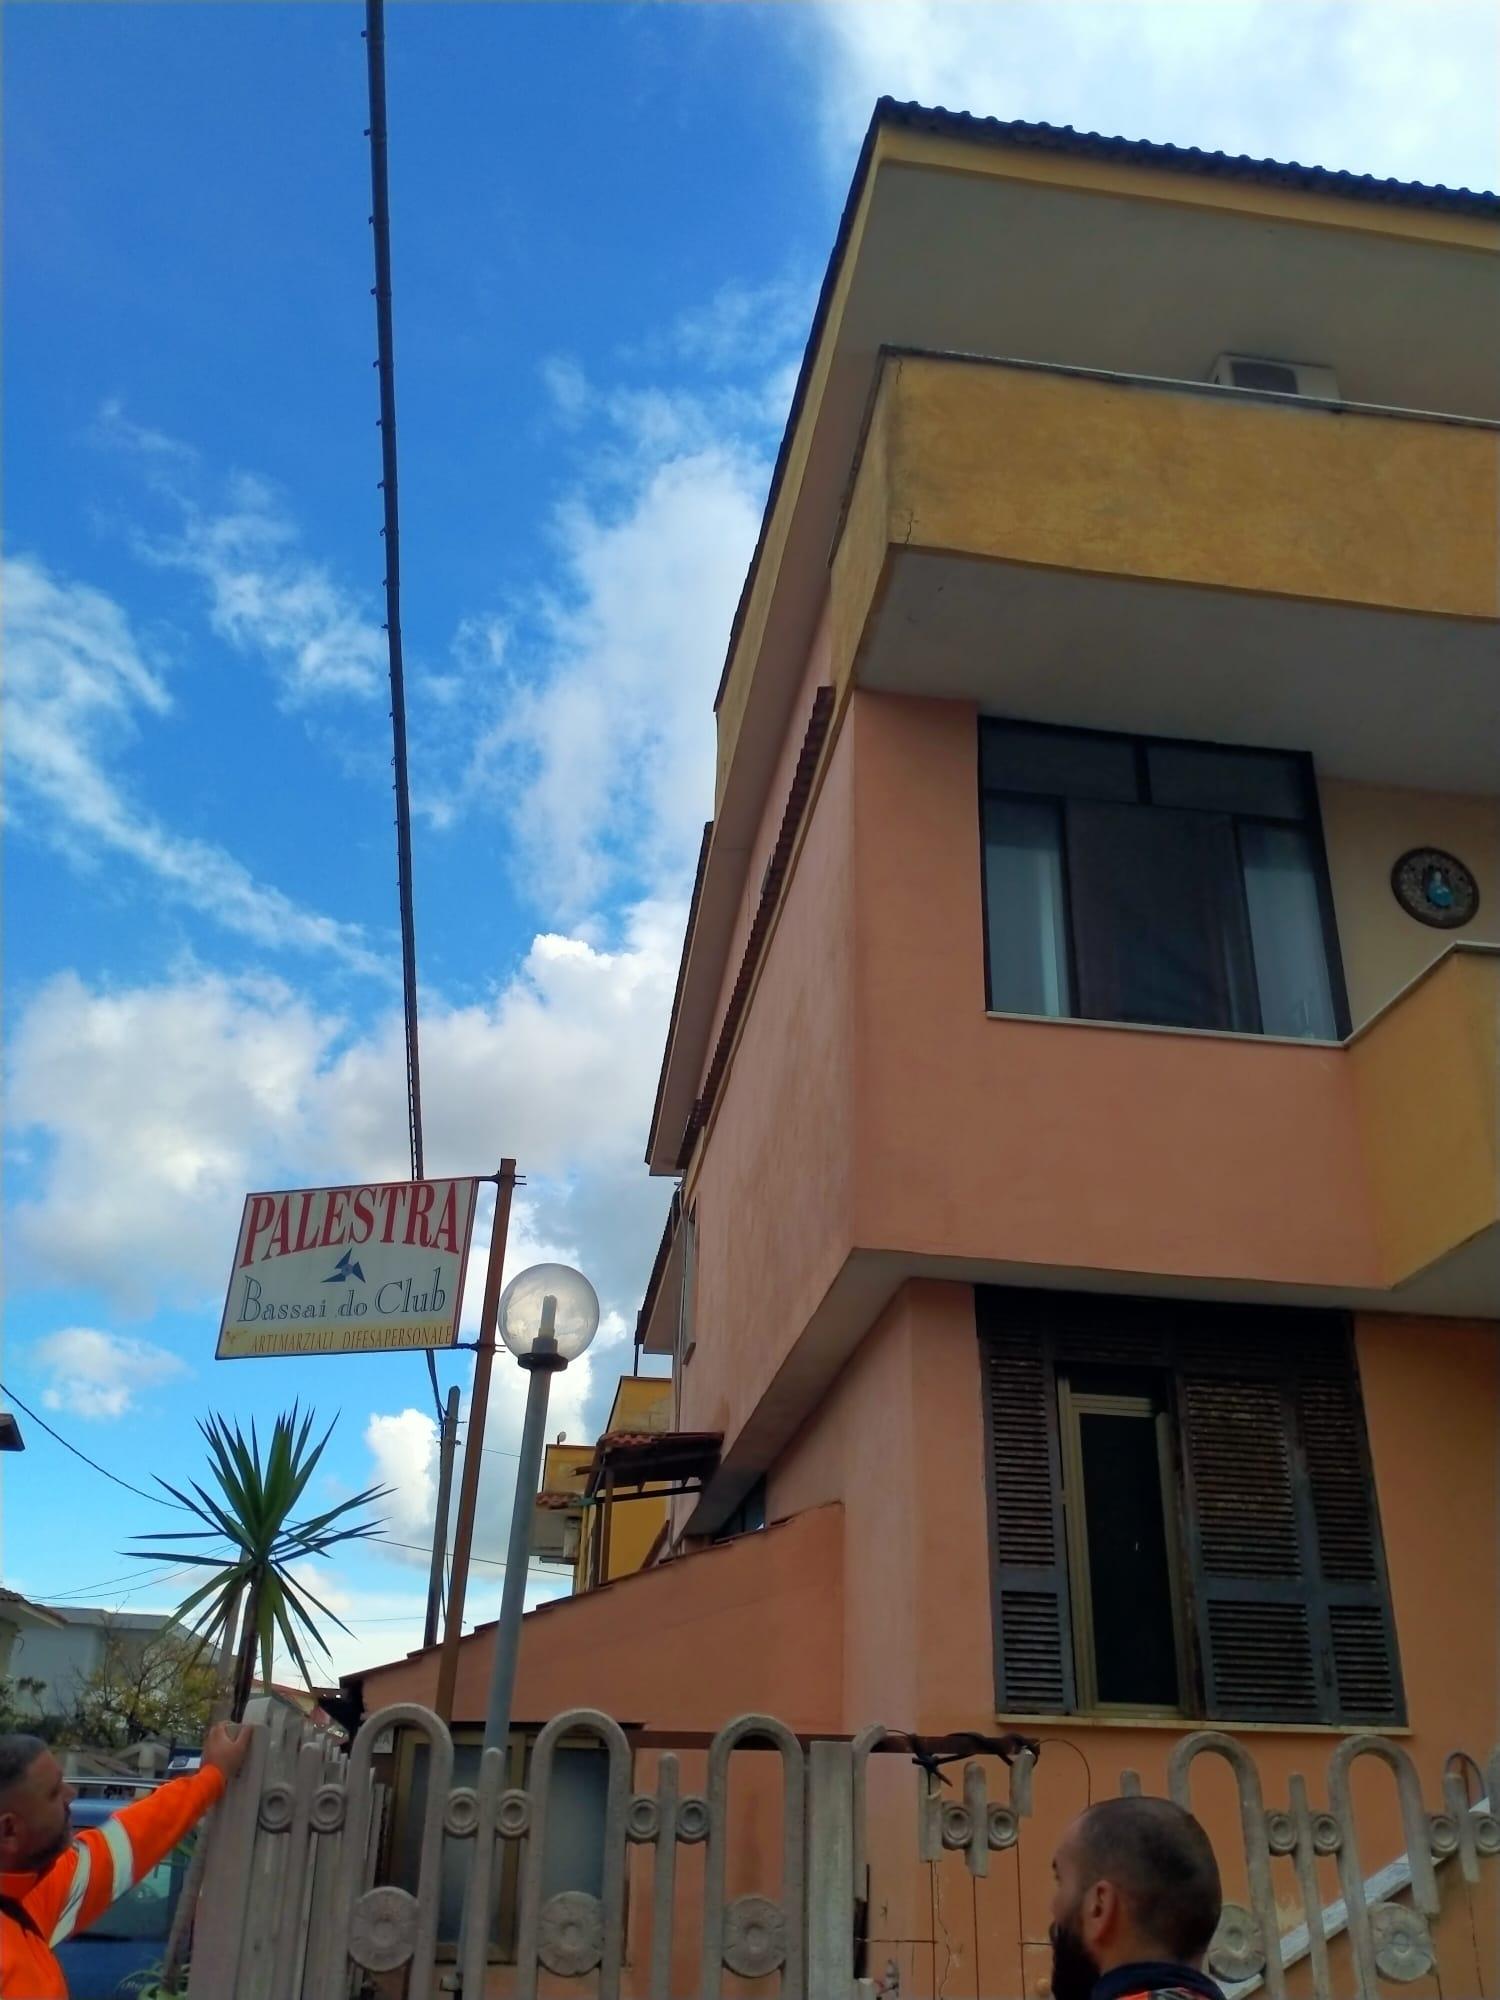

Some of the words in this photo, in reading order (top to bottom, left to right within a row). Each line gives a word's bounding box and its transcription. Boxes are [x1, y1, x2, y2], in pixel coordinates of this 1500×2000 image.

[239, 1182, 459, 1268] PALESTRA
[237, 1275, 326, 1322] Bassai
[338, 1290, 367, 1316] do
[375, 1267, 446, 1314] Club
